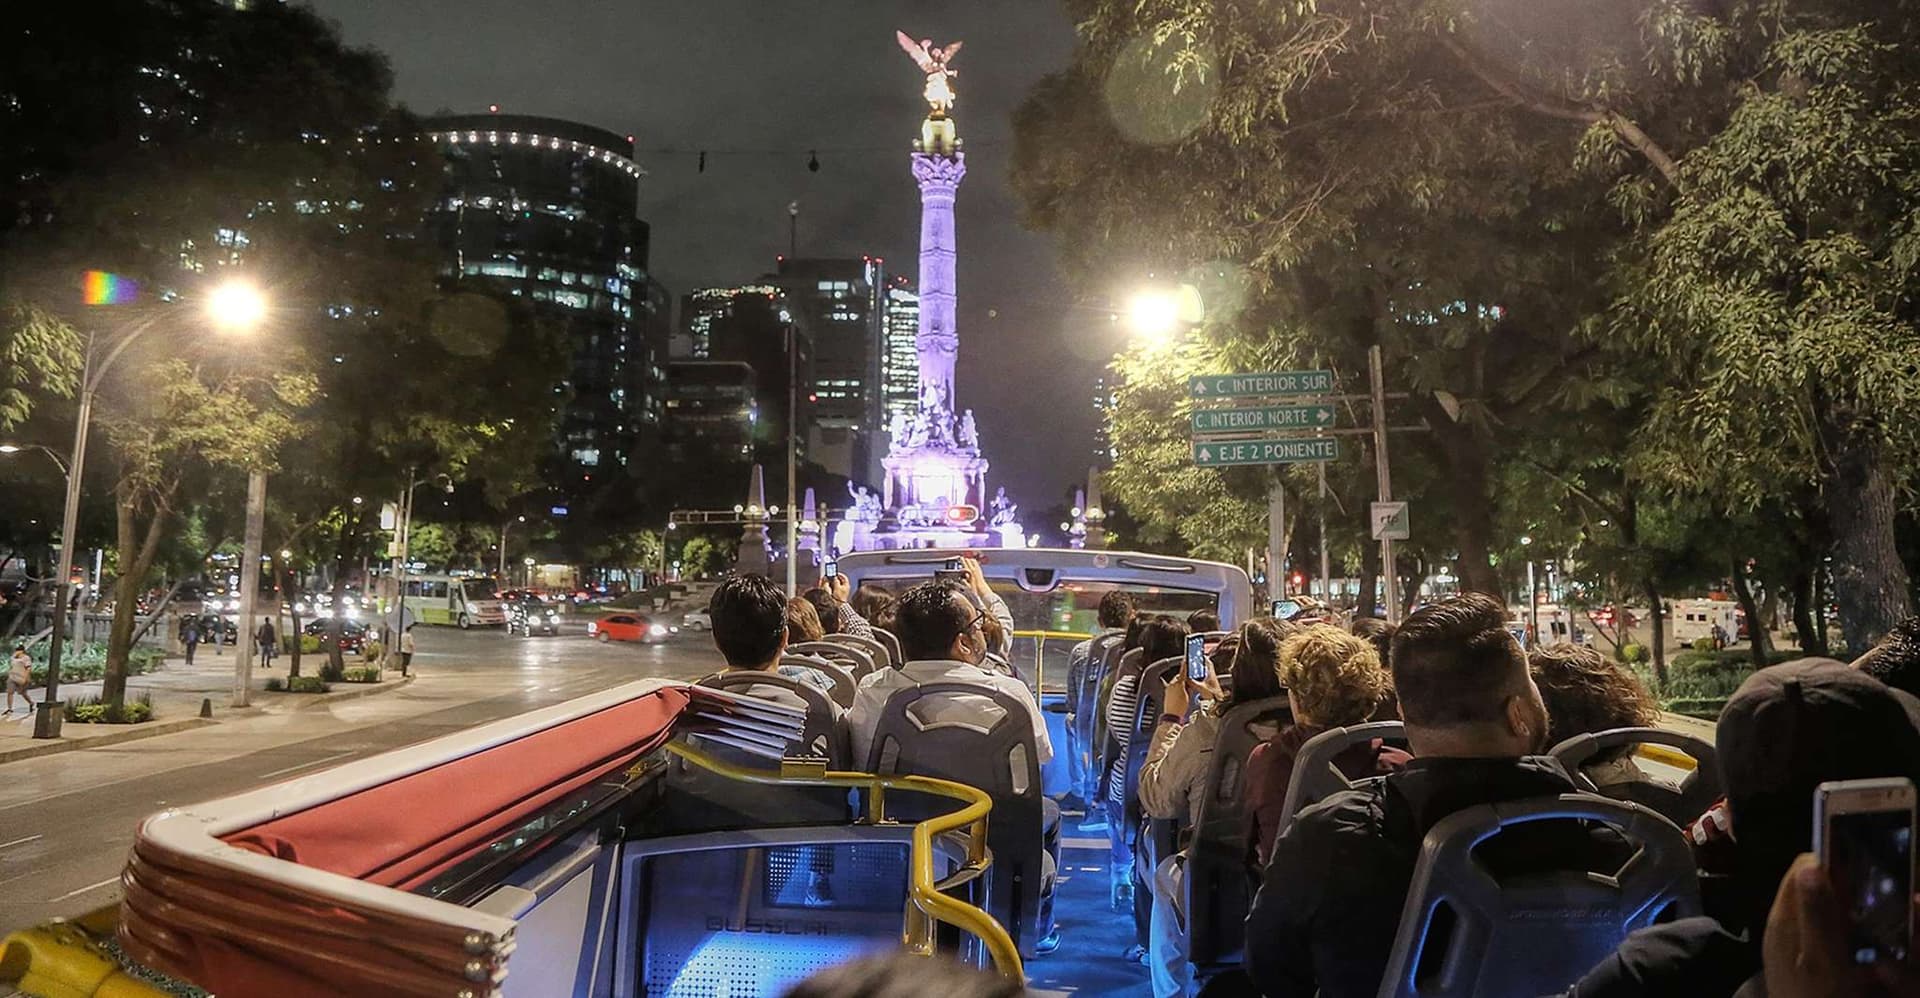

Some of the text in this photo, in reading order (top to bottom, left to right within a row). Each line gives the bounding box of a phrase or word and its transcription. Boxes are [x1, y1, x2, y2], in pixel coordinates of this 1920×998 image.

[1216, 375, 1328, 394] C. INTERIOR SUR
[1195, 409, 1309, 428] C. INTERIOR NORTE
[1219, 441, 1334, 461] EJE 2 PONIENTE
